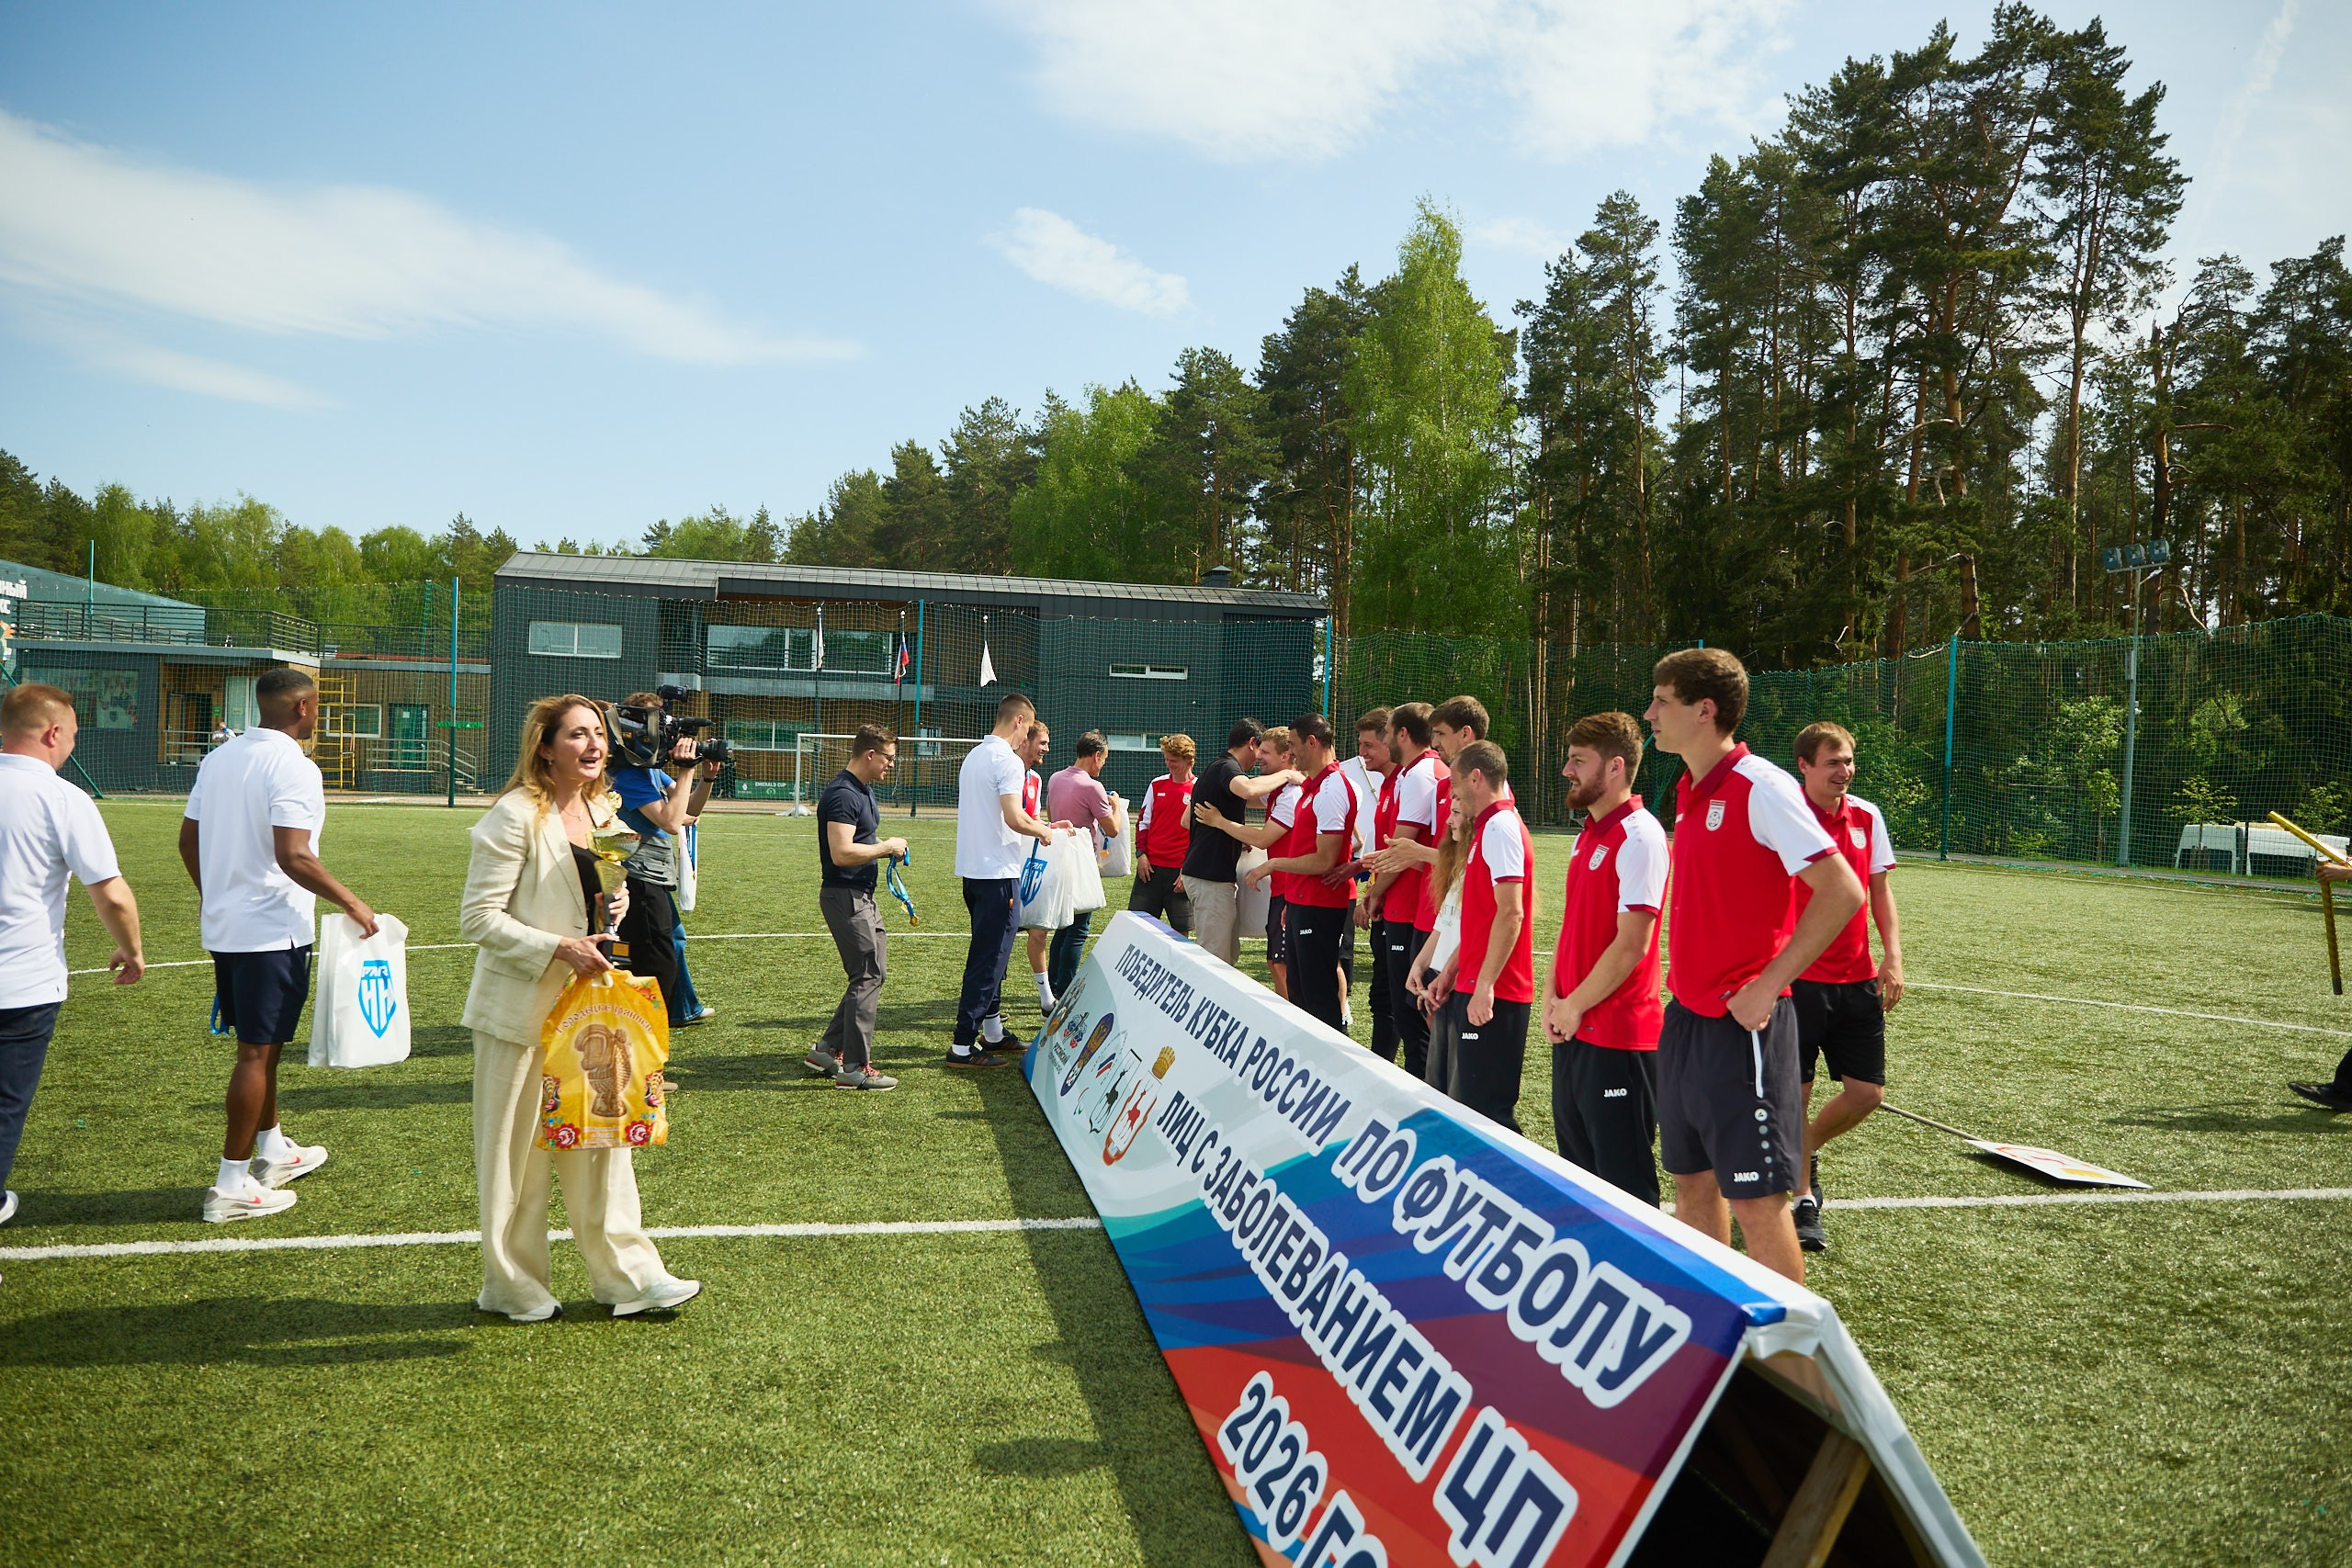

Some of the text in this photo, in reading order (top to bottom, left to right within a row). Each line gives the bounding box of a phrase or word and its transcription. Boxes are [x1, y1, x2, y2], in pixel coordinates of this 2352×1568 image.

[1114, 943, 1677, 1391] ПОБЕДИТЕЛЬ КУБКА РОССИИ ПО ФУТБОЛУ
[1603, 1088, 1628, 1098] JAKO
[1733, 1171, 1759, 1182] JAKO
[1156, 1090, 1566, 1568] ЛИЦ С ЗАБОЛЕВАНИЕМ ЦП
[1225, 1382, 1319, 1539] 2026
